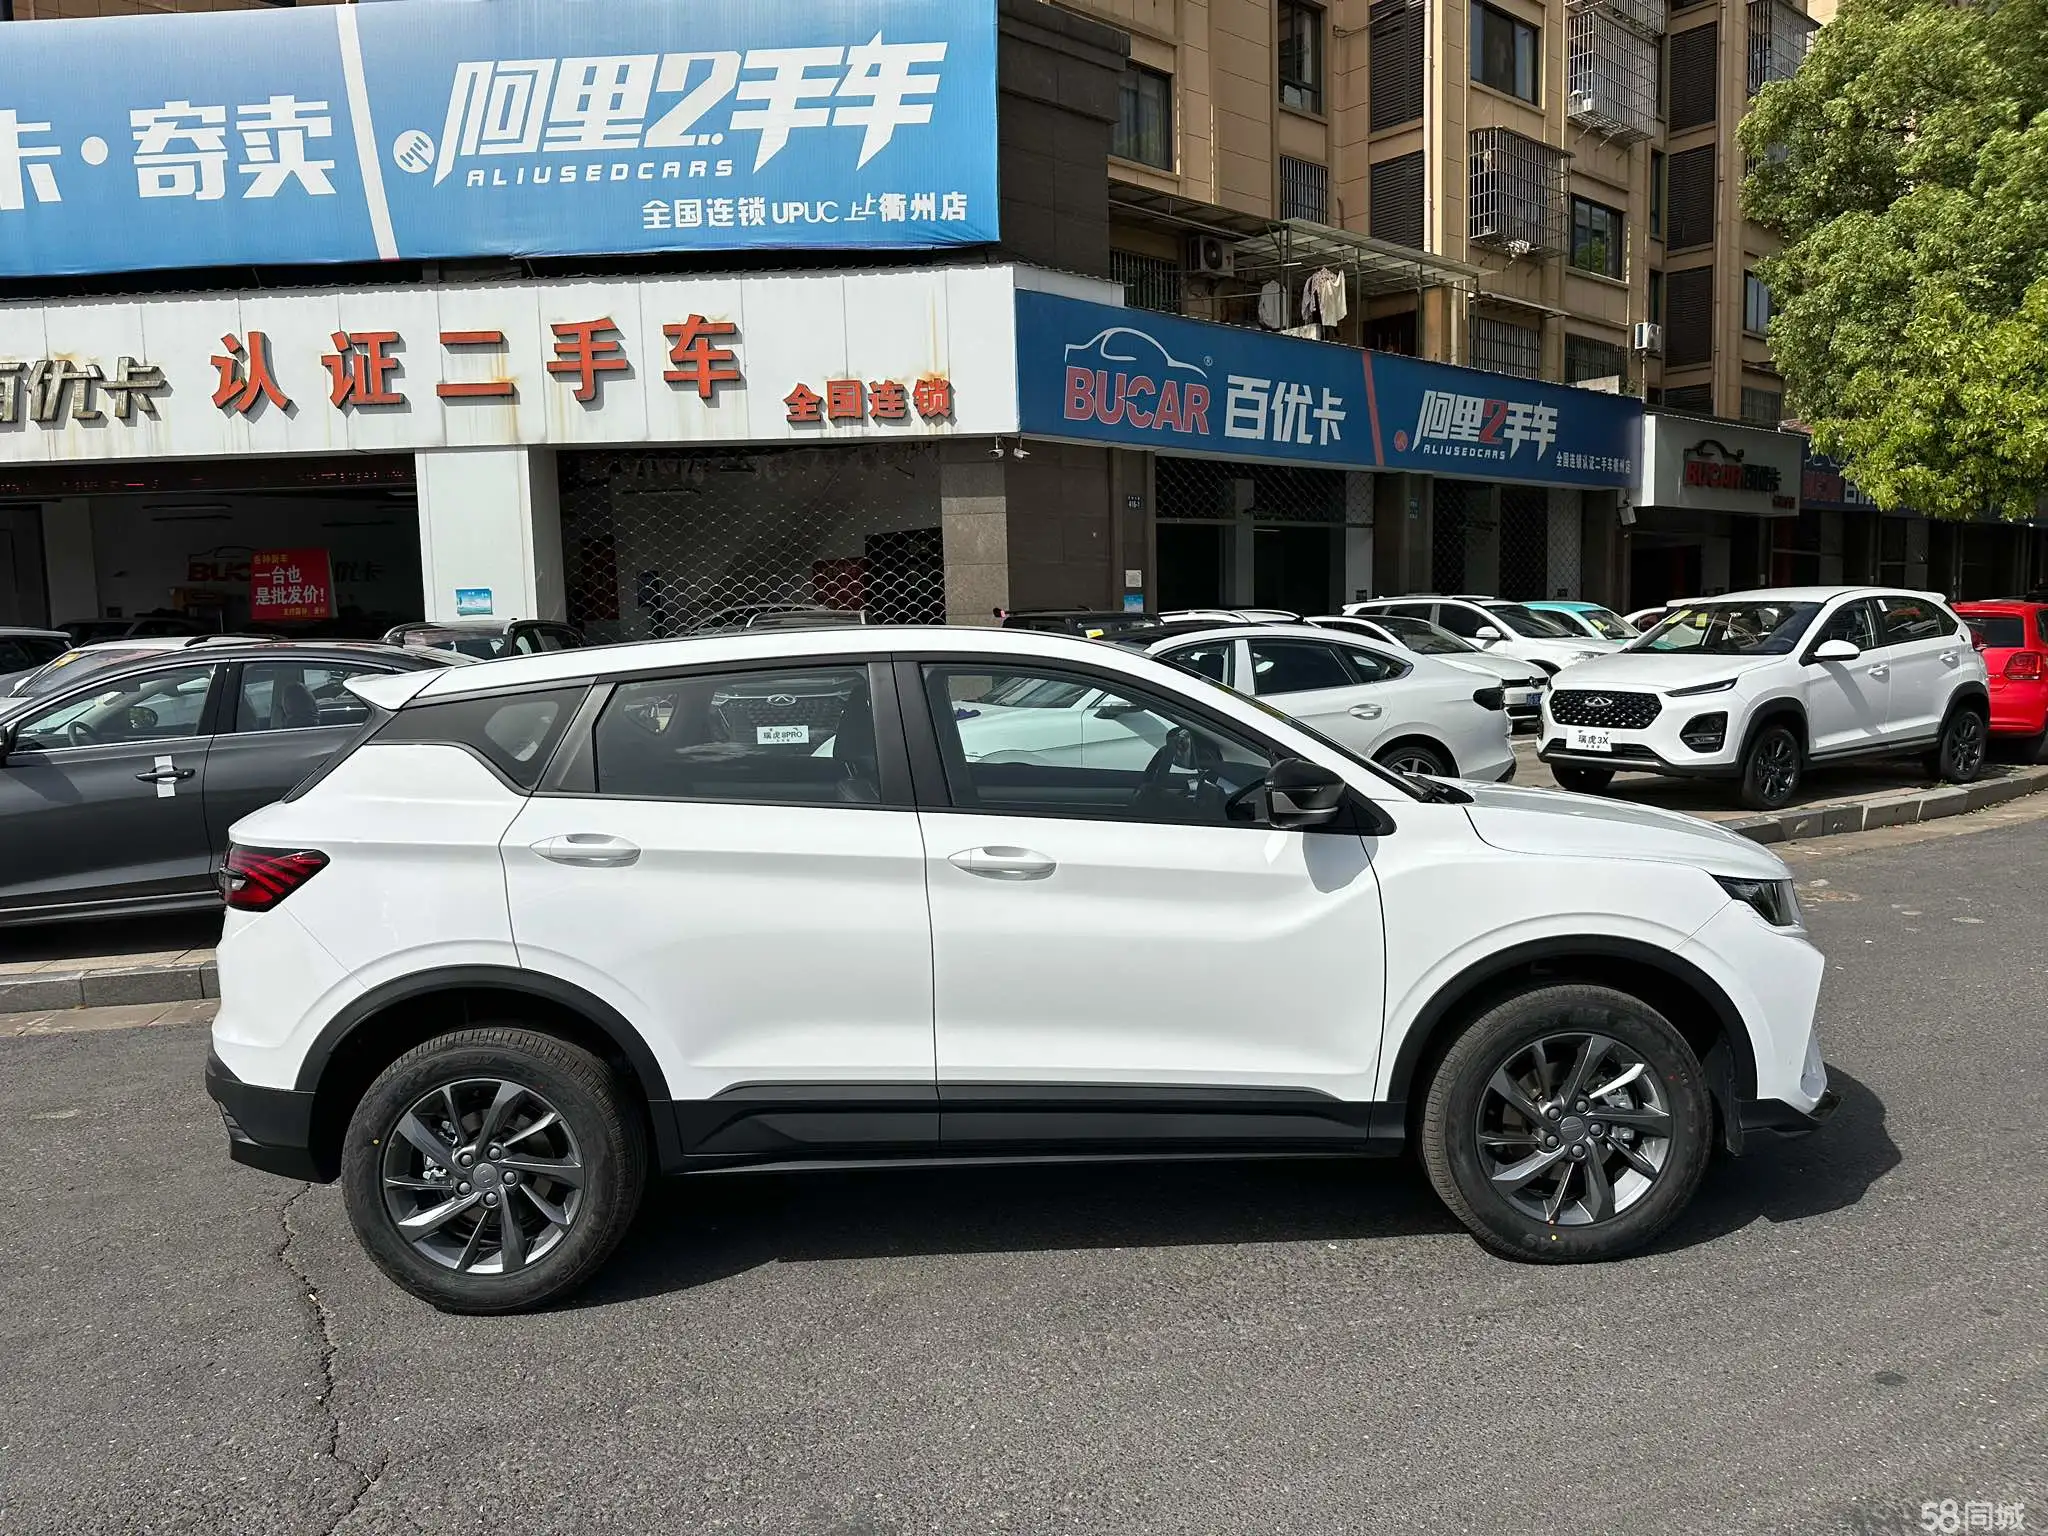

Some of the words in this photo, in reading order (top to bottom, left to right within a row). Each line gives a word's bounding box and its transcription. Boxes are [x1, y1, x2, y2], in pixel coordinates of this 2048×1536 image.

[434, 30, 948, 187] 阿里2手车
[466, 159, 733, 187] ALIUSEDCARS
[642, 196, 766, 229] 全国连锁
[772, 201, 839, 224] UPUC
[210, 314, 741, 415] 认证二手车
[783, 377, 951, 422] 全国连锁
[1063, 365, 1211, 435] BUCAR
[1224, 375, 1347, 445] 百优卡
[1412, 390, 1558, 462] 阿里2手车
[1424, 444, 1506, 460] ALIUSEDCARS
[254, 564, 302, 585] 一台也
[255, 585, 325, 605] 是批发价!
